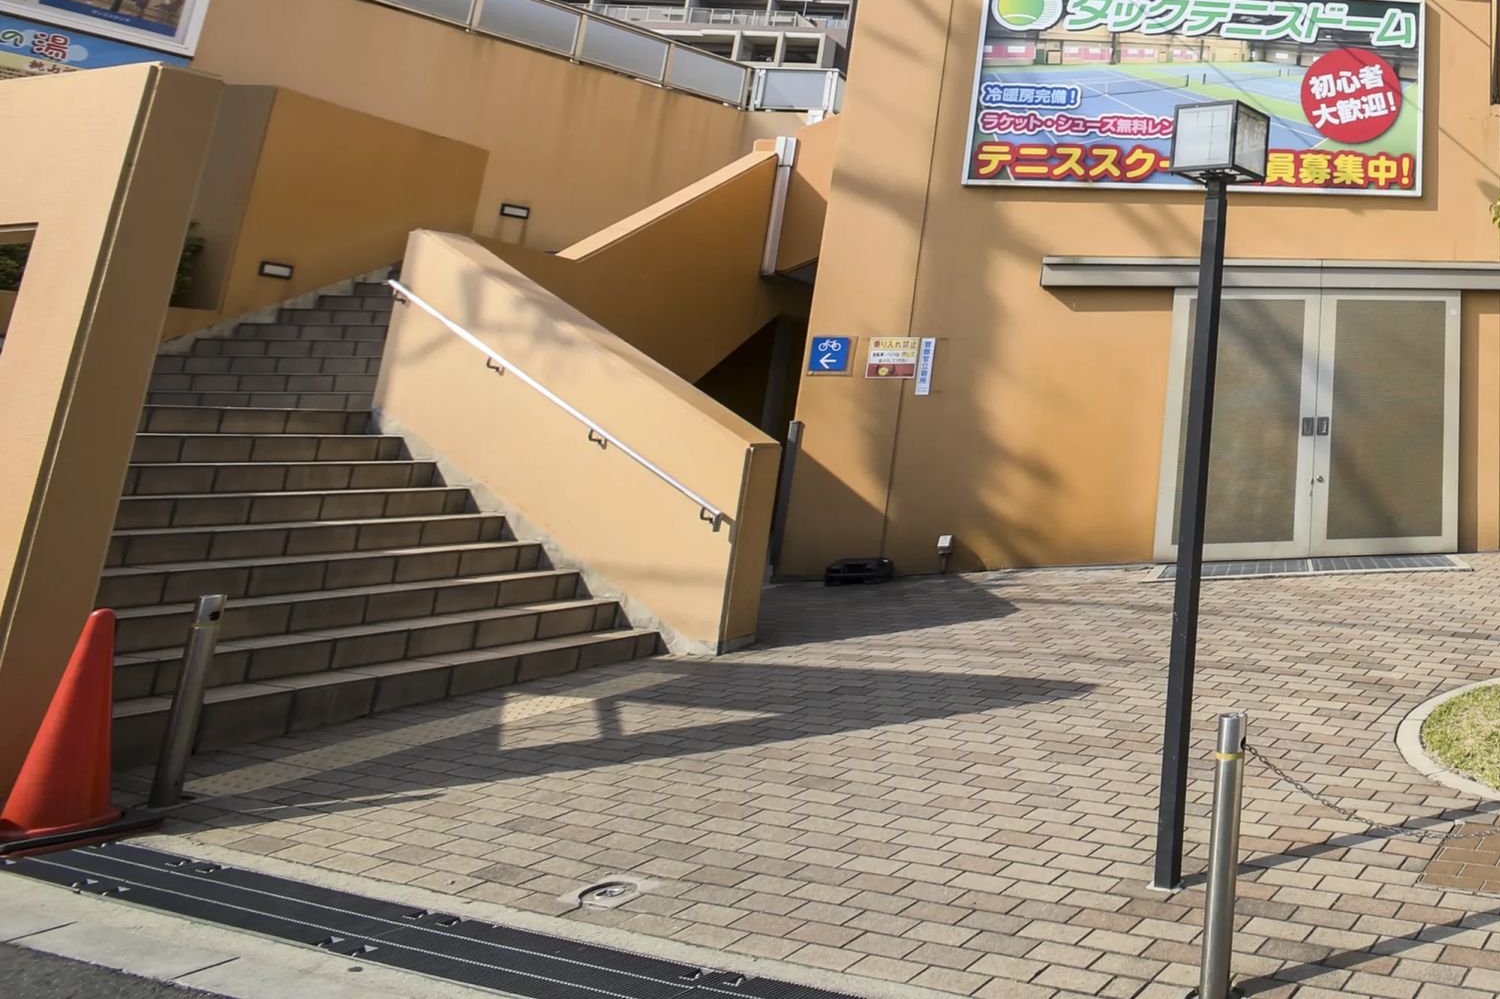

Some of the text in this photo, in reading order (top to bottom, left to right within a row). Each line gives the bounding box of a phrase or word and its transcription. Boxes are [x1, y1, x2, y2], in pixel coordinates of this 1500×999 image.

[983, 86, 1078, 105] 冷暖房完備!
[1308, 62, 1385, 101] 初心者
[982, 114, 1173, 135] ラケット・シューズ無料レン
[1311, 92, 1398, 130] 大歓迎!
